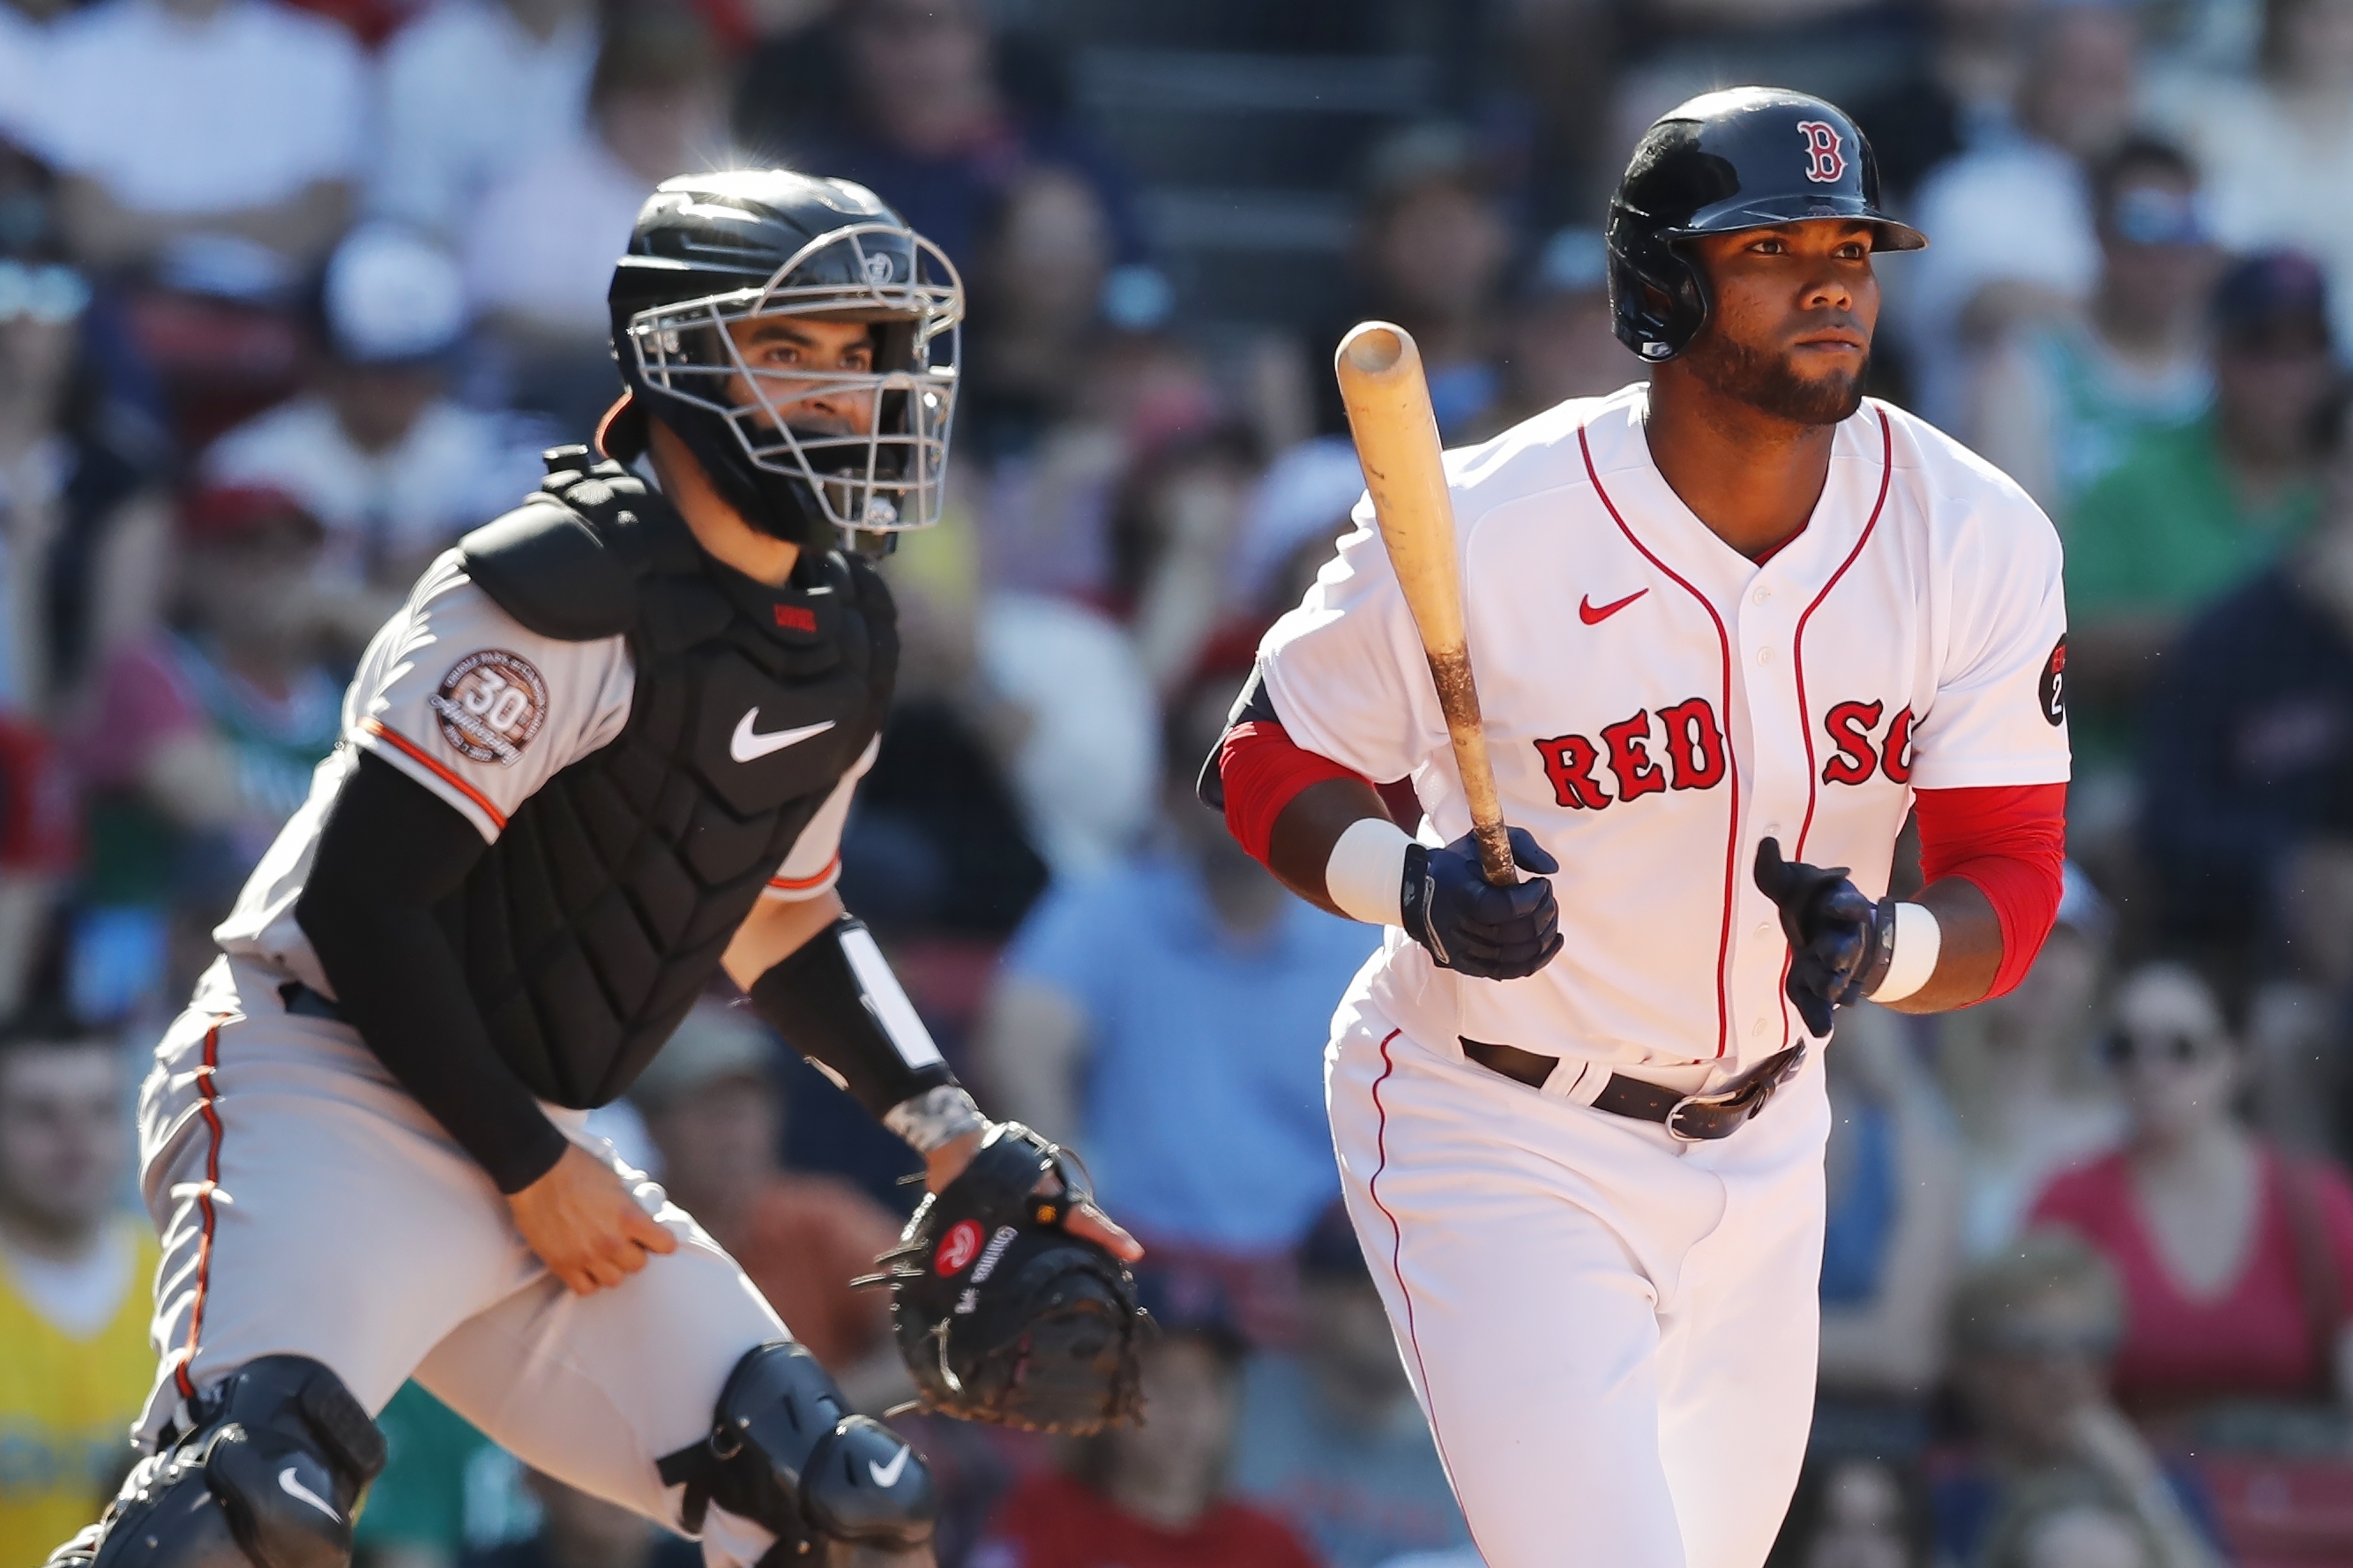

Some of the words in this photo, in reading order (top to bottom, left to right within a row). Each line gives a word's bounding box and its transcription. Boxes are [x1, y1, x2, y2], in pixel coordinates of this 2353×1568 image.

[1796, 120, 1849, 183] B
[466, 666, 529, 733] 30
[2051, 673, 2063, 715] 2
[1533, 698, 1724, 810] RED
[1821, 698, 1913, 786] SO
